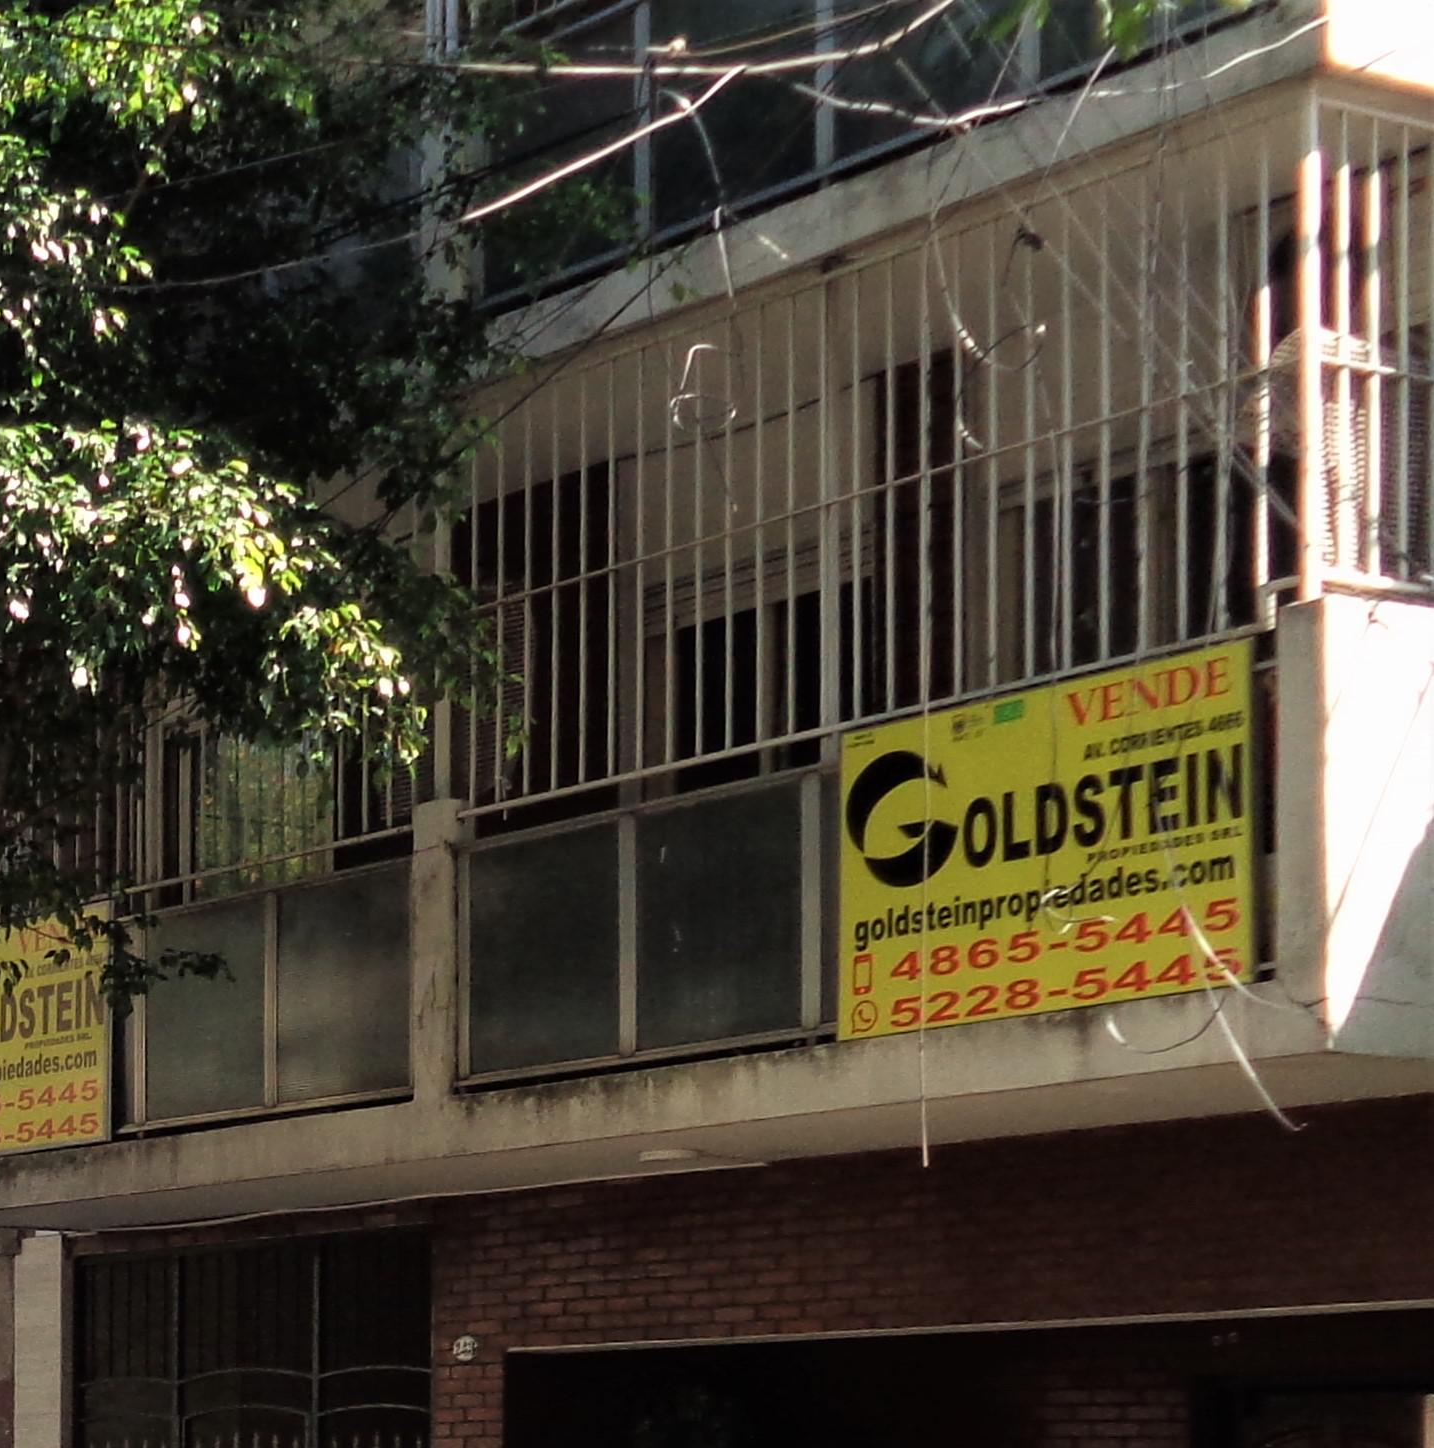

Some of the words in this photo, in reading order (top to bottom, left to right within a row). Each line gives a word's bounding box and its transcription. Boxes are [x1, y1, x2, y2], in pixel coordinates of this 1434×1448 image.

[1066, 656, 1230, 726] VENDE
[845, 743, 1244, 887] GOLDSTEIN
[1087, 833, 1205, 863] PROPIEDADES
[854, 855, 1235, 951] goldsteinpropiedades.com
[890, 897, 1241, 982] 4865-5445
[889, 947, 1243, 1028] 5228-5445
